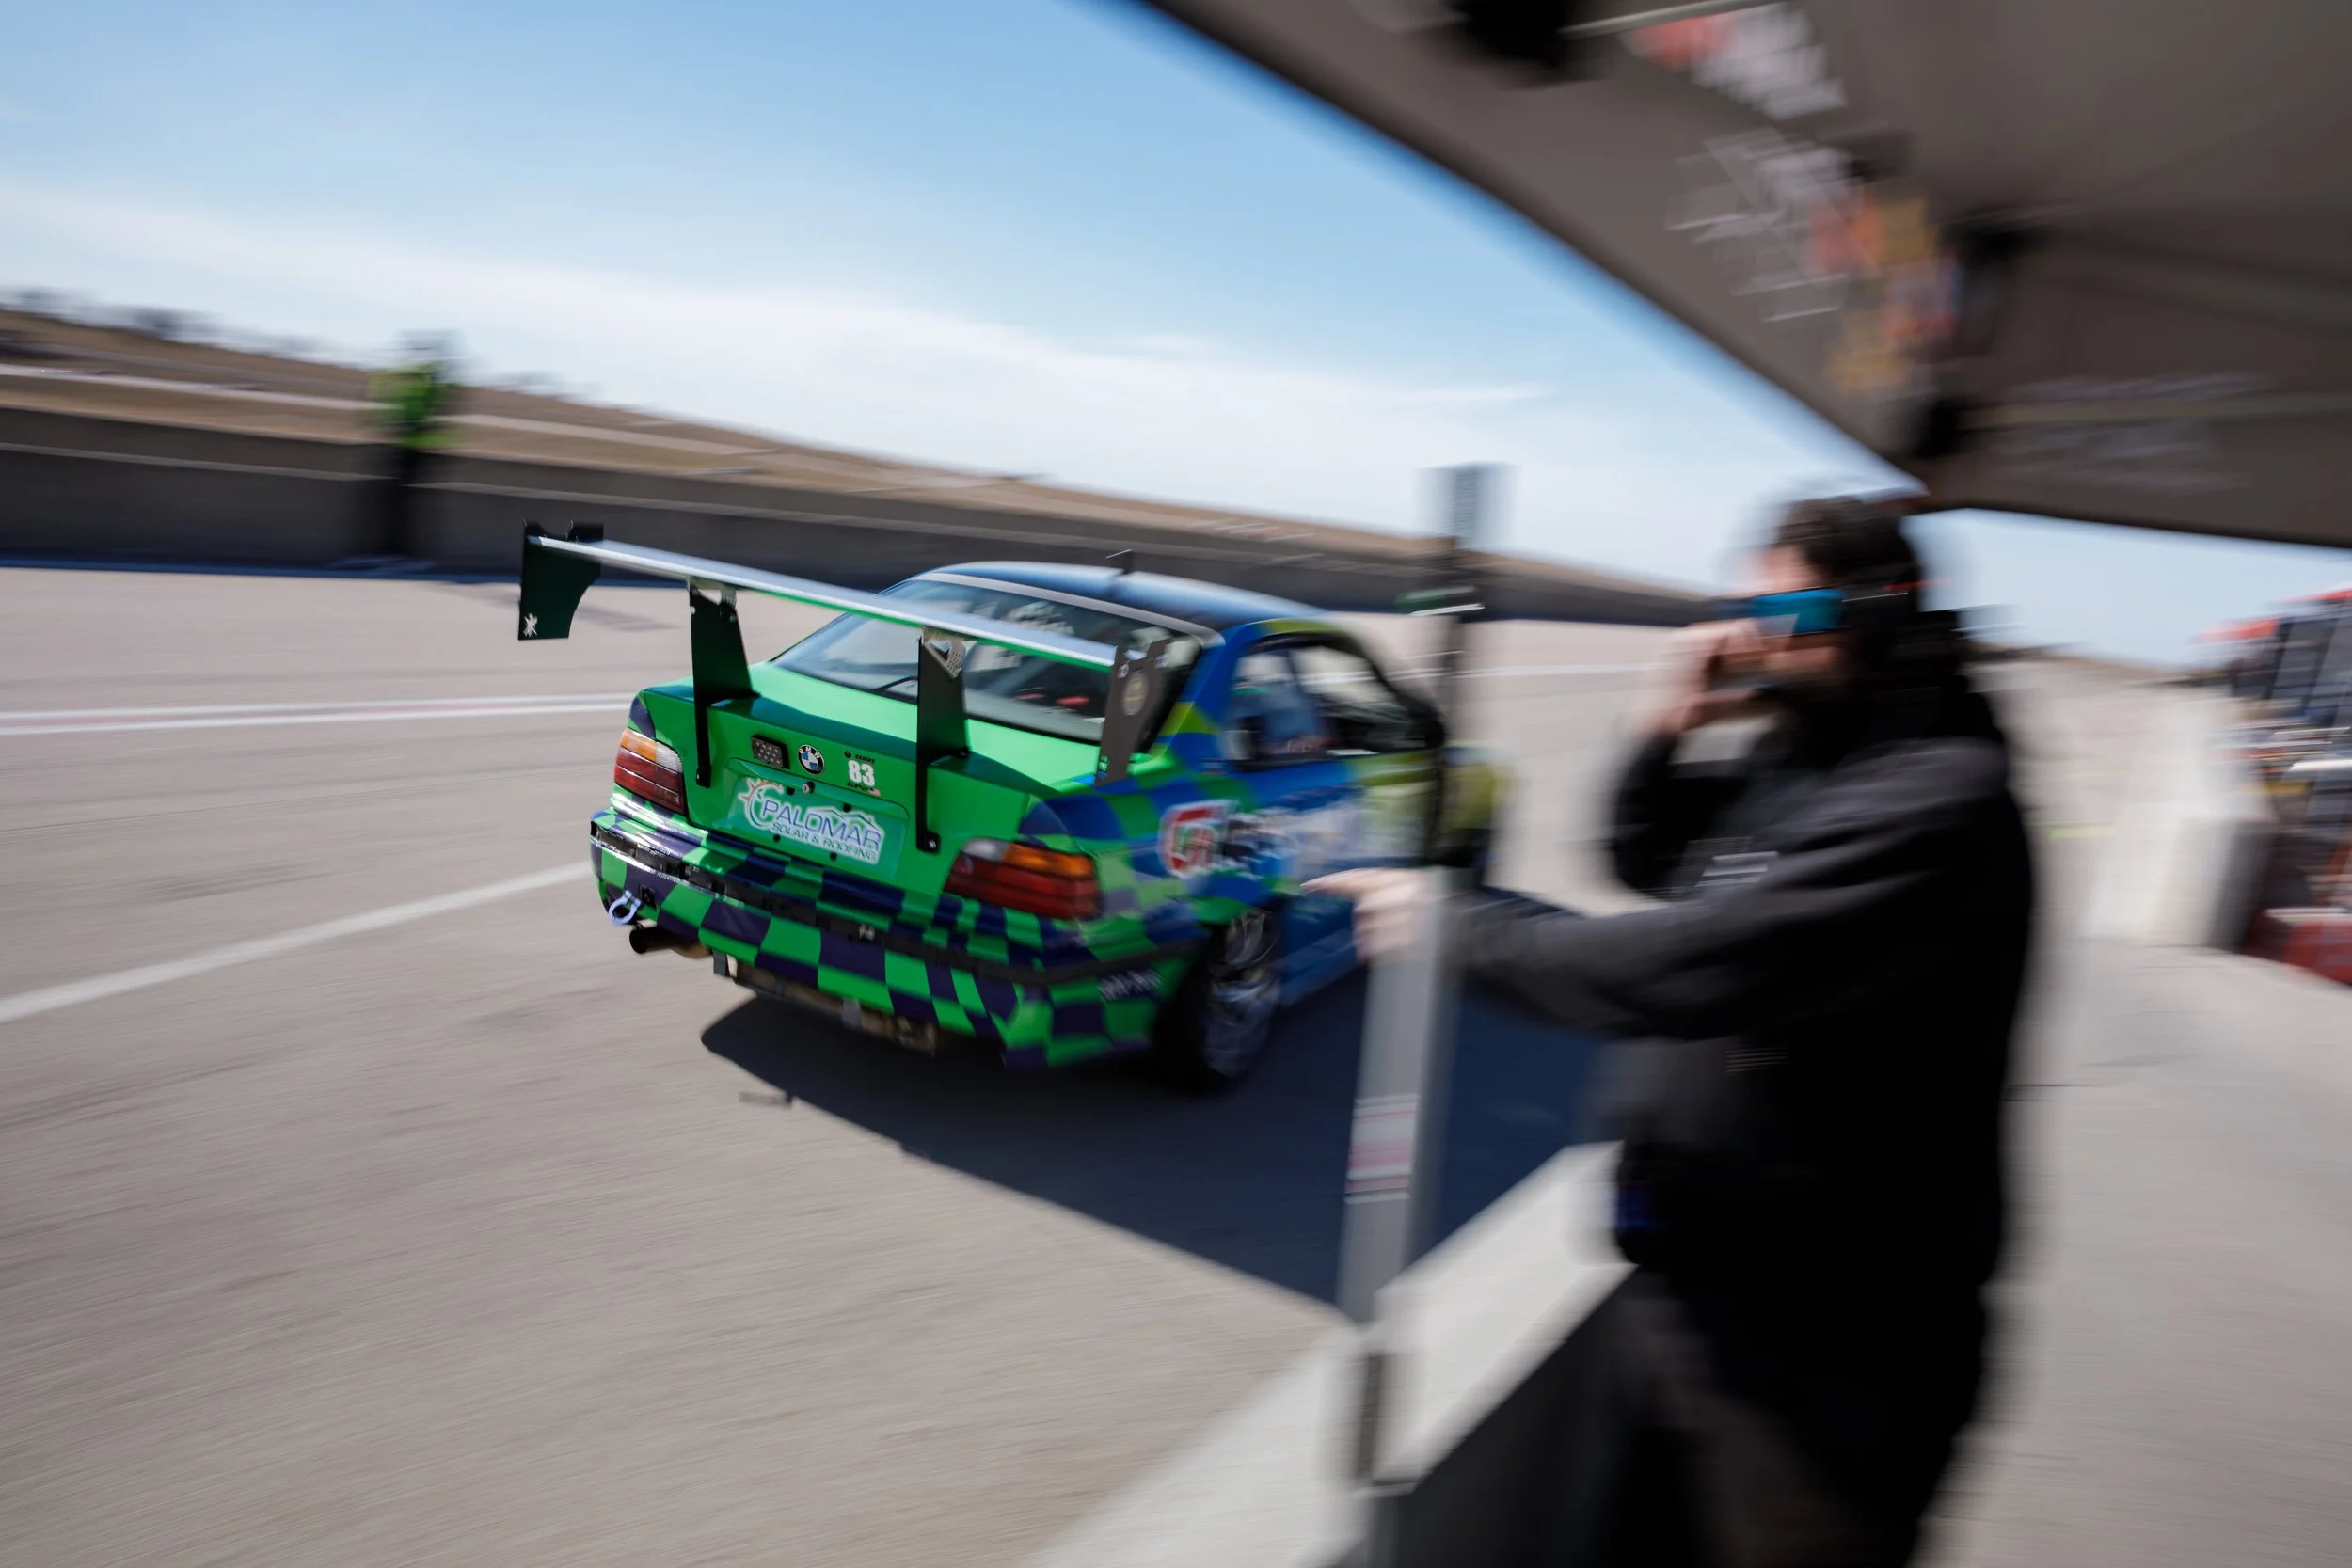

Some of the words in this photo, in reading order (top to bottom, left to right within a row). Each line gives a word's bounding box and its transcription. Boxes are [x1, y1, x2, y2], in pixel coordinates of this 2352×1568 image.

[848, 760, 875, 786] 83
[762, 800, 882, 852] PALOMAR
[771, 821, 809, 841] SOLAR
[811, 834, 820, 845] &
[823, 839, 877, 862] ROOFING
